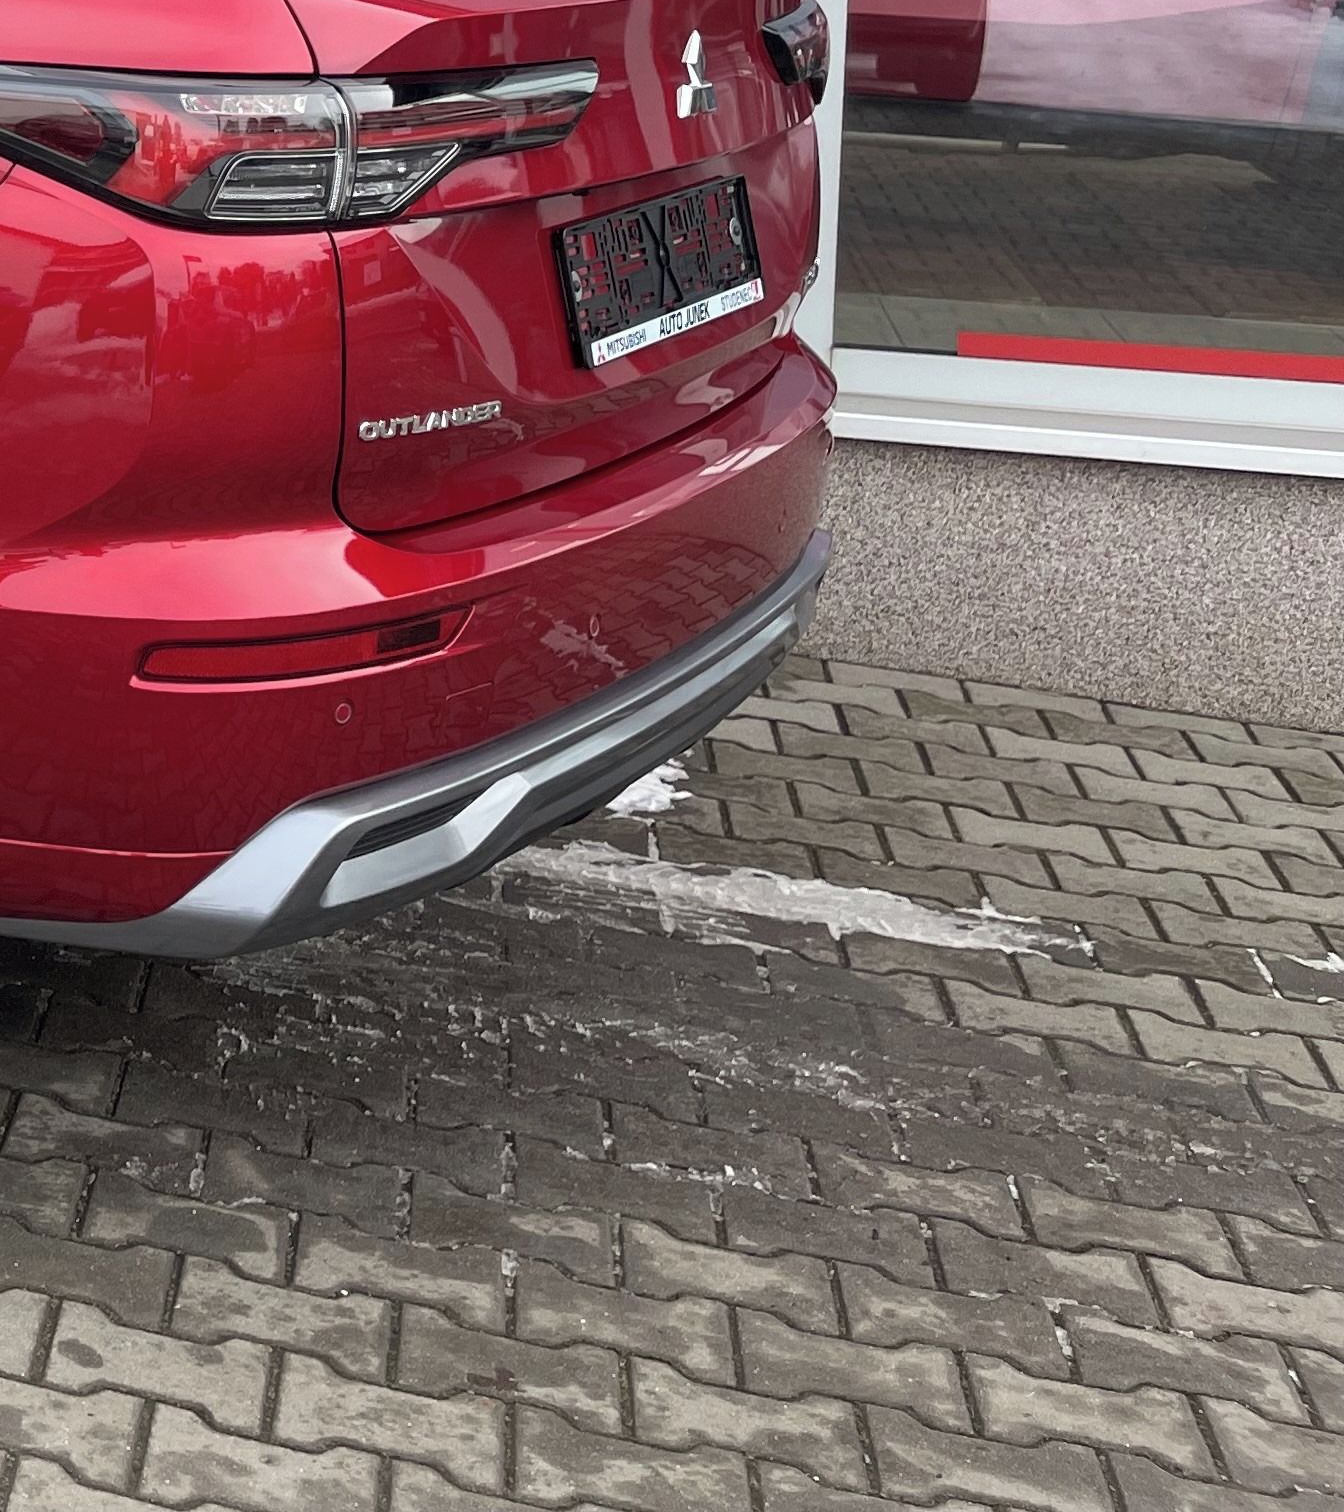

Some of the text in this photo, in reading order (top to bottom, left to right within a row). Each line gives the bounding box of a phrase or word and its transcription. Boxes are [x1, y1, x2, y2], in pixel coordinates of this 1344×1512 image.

[606, 328, 647, 356] MITSUBISHI
[659, 311, 683, 338] AUTO
[685, 300, 710, 328] JUNEK
[358, 399, 502, 441] OUTLANDER
